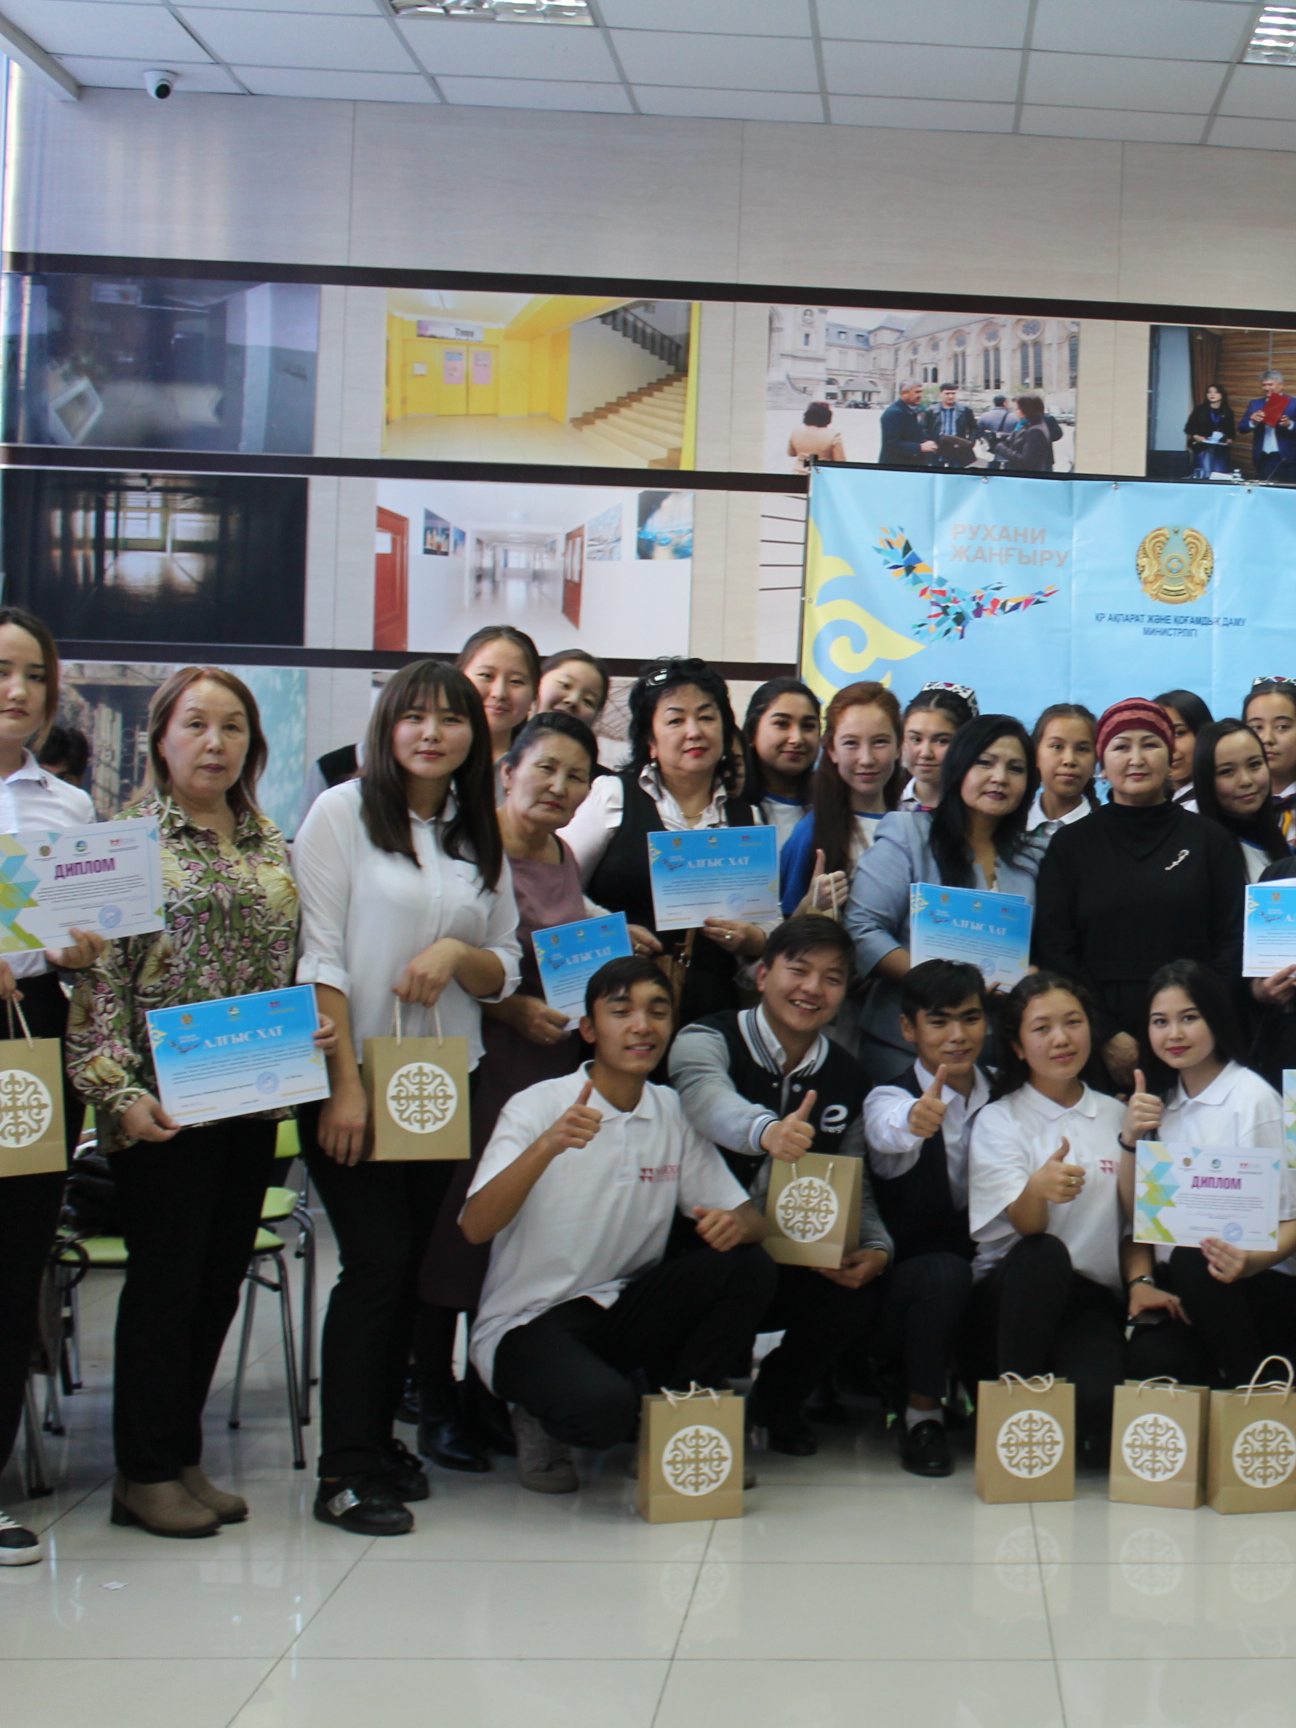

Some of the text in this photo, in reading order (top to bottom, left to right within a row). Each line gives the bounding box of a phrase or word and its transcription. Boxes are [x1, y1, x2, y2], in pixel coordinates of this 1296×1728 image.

[951, 523, 1046, 545] РУХАНИ
[949, 545, 1070, 567] ЖАҢҒЫРУ
[1147, 614, 1171, 624] ЖӘНЕ
[1222, 617, 1247, 627] ДАМУ
[54, 857, 117, 881] ДИПЛОМ
[1191, 1175, 1242, 1190] ДИПЛОМ
